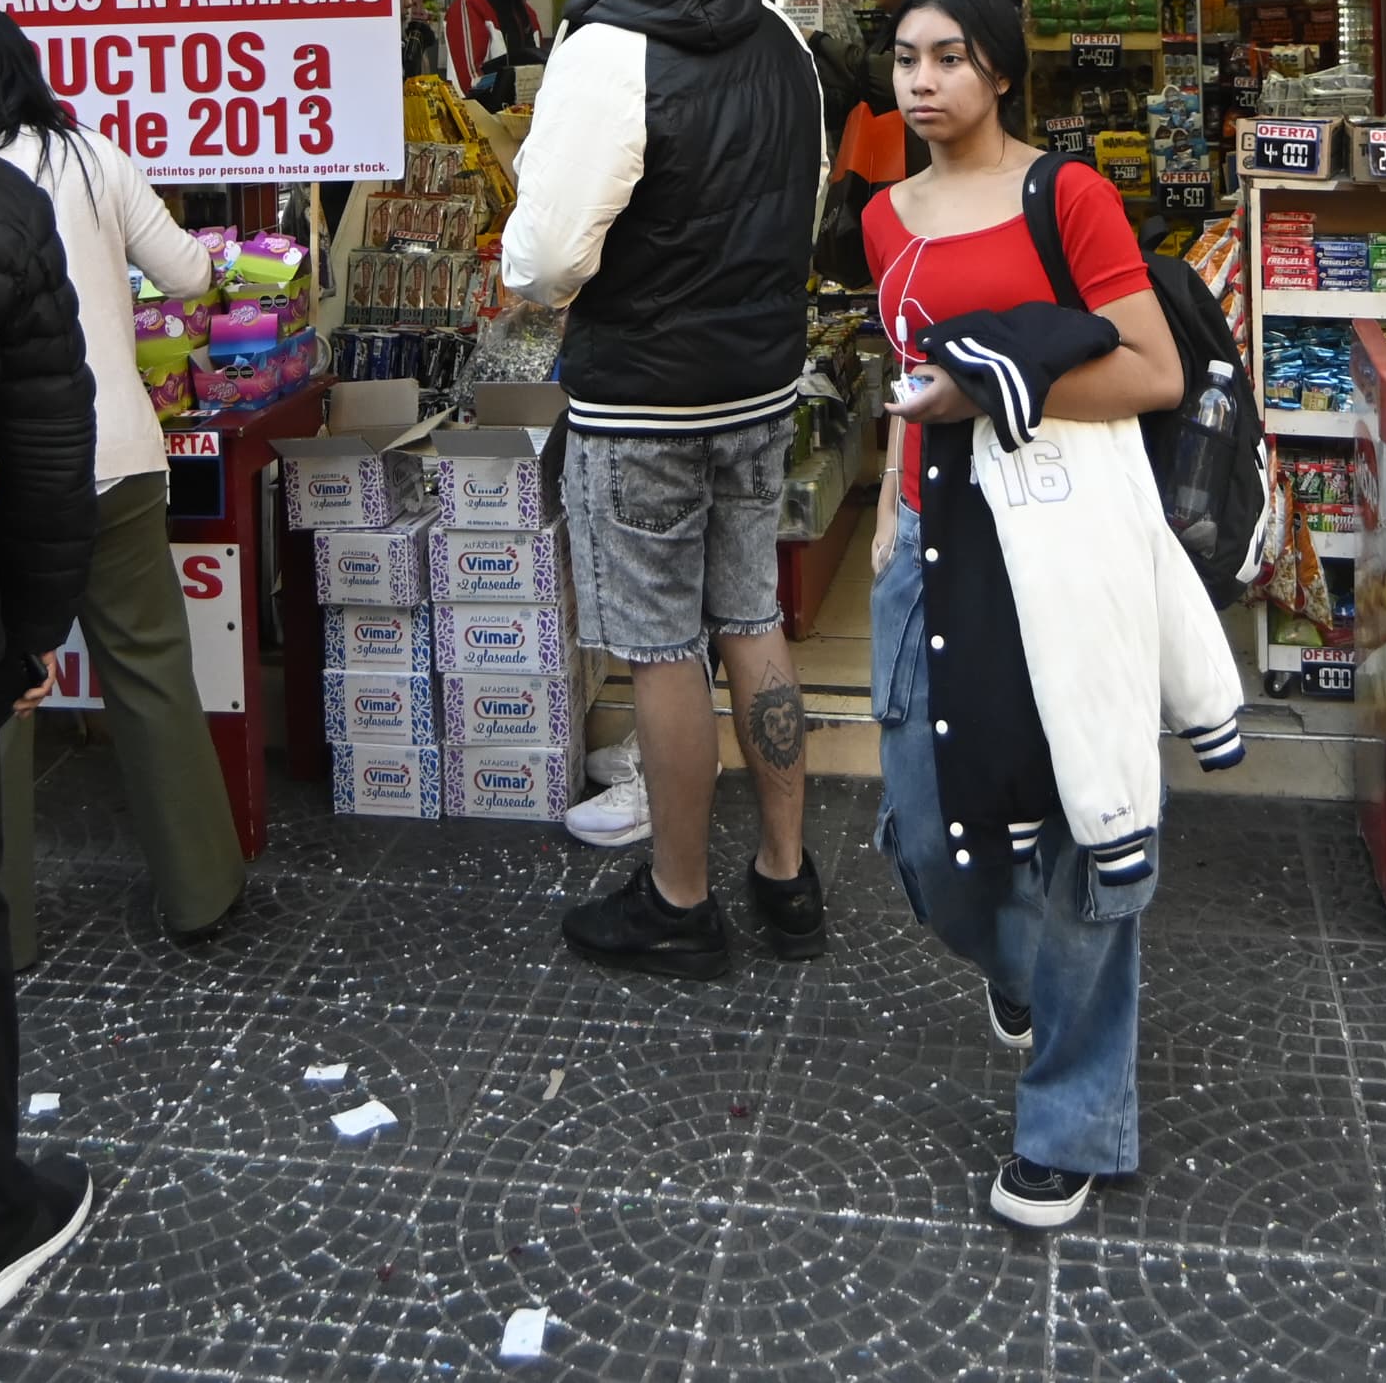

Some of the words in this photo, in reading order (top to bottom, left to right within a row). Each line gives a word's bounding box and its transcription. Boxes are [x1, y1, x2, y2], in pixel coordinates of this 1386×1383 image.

[1074, 34, 1119, 44] OFERTA
[28, 31, 266, 97] UCTOS
[293, 43, 332, 92] a
[100, 99, 168, 158] de
[188, 95, 333, 157] 2013
[1047, 116, 1084, 129] OFERTA
[1259, 125, 1316, 139] OFERTA
[147, 166, 196, 177] distintos
[198, 168, 217, 179] por
[220, 167, 266, 179] persona
[268, 167, 276, 176] o
[278, 164, 310, 175] hasta
[313, 163, 351, 177] agotar
[353, 161, 391, 173] stock.
[1161, 172, 1210, 183] OFERTA
[989, 439, 1072, 508] 16
[313, 484, 348, 495] Vimar
[318, 499, 351, 510] glaseado
[473, 499, 508, 510] glaseado
[343, 561, 377, 573] Vimar
[466, 556, 513, 572] Vimar
[470, 576, 523, 596] glaseado
[470, 615, 510, 624] ALFAJORES
[360, 627, 397, 640] Vimar
[472, 630, 519, 645] Vimar
[363, 644, 404, 656] glaseado
[477, 649, 528, 666] glaseado
[480, 685, 520, 694] ALFAJORES
[361, 699, 396, 712] Vimar
[482, 701, 529, 715] Vimar
[363, 715, 404, 728] glaseado
[485, 720, 538, 737] glaseado
[479, 758, 519, 767] ALFAJORES
[370, 771, 405, 784] Vimar
[482, 773, 528, 788] Vimar
[372, 787, 412, 799] glaseado
[485, 791, 537, 810] glaseado
